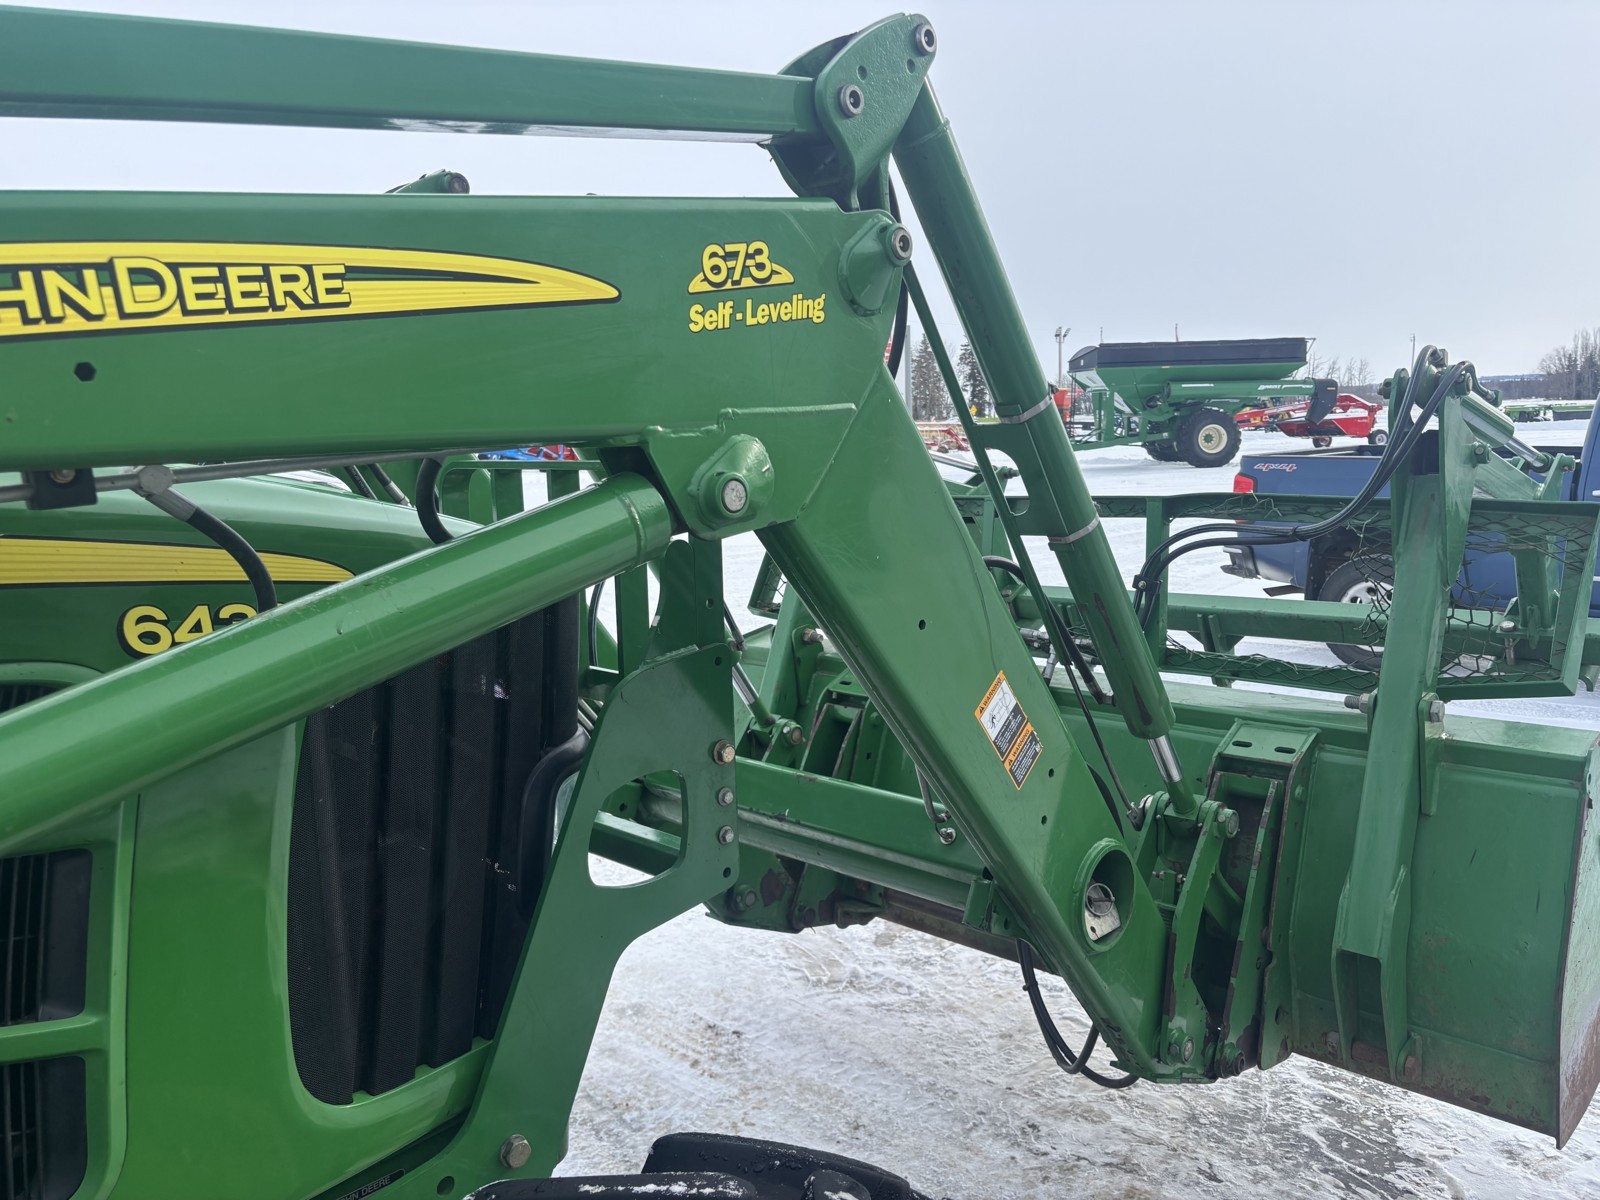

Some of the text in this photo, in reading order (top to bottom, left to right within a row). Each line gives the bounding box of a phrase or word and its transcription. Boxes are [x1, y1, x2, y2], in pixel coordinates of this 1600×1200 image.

[701, 240, 772, 287] 673
[109, 256, 352, 319] DEERE
[983, 677, 1002, 706] WARNING
[1012, 728, 1030, 757] WARNING
[361, 1175, 392, 1196] DEERE
